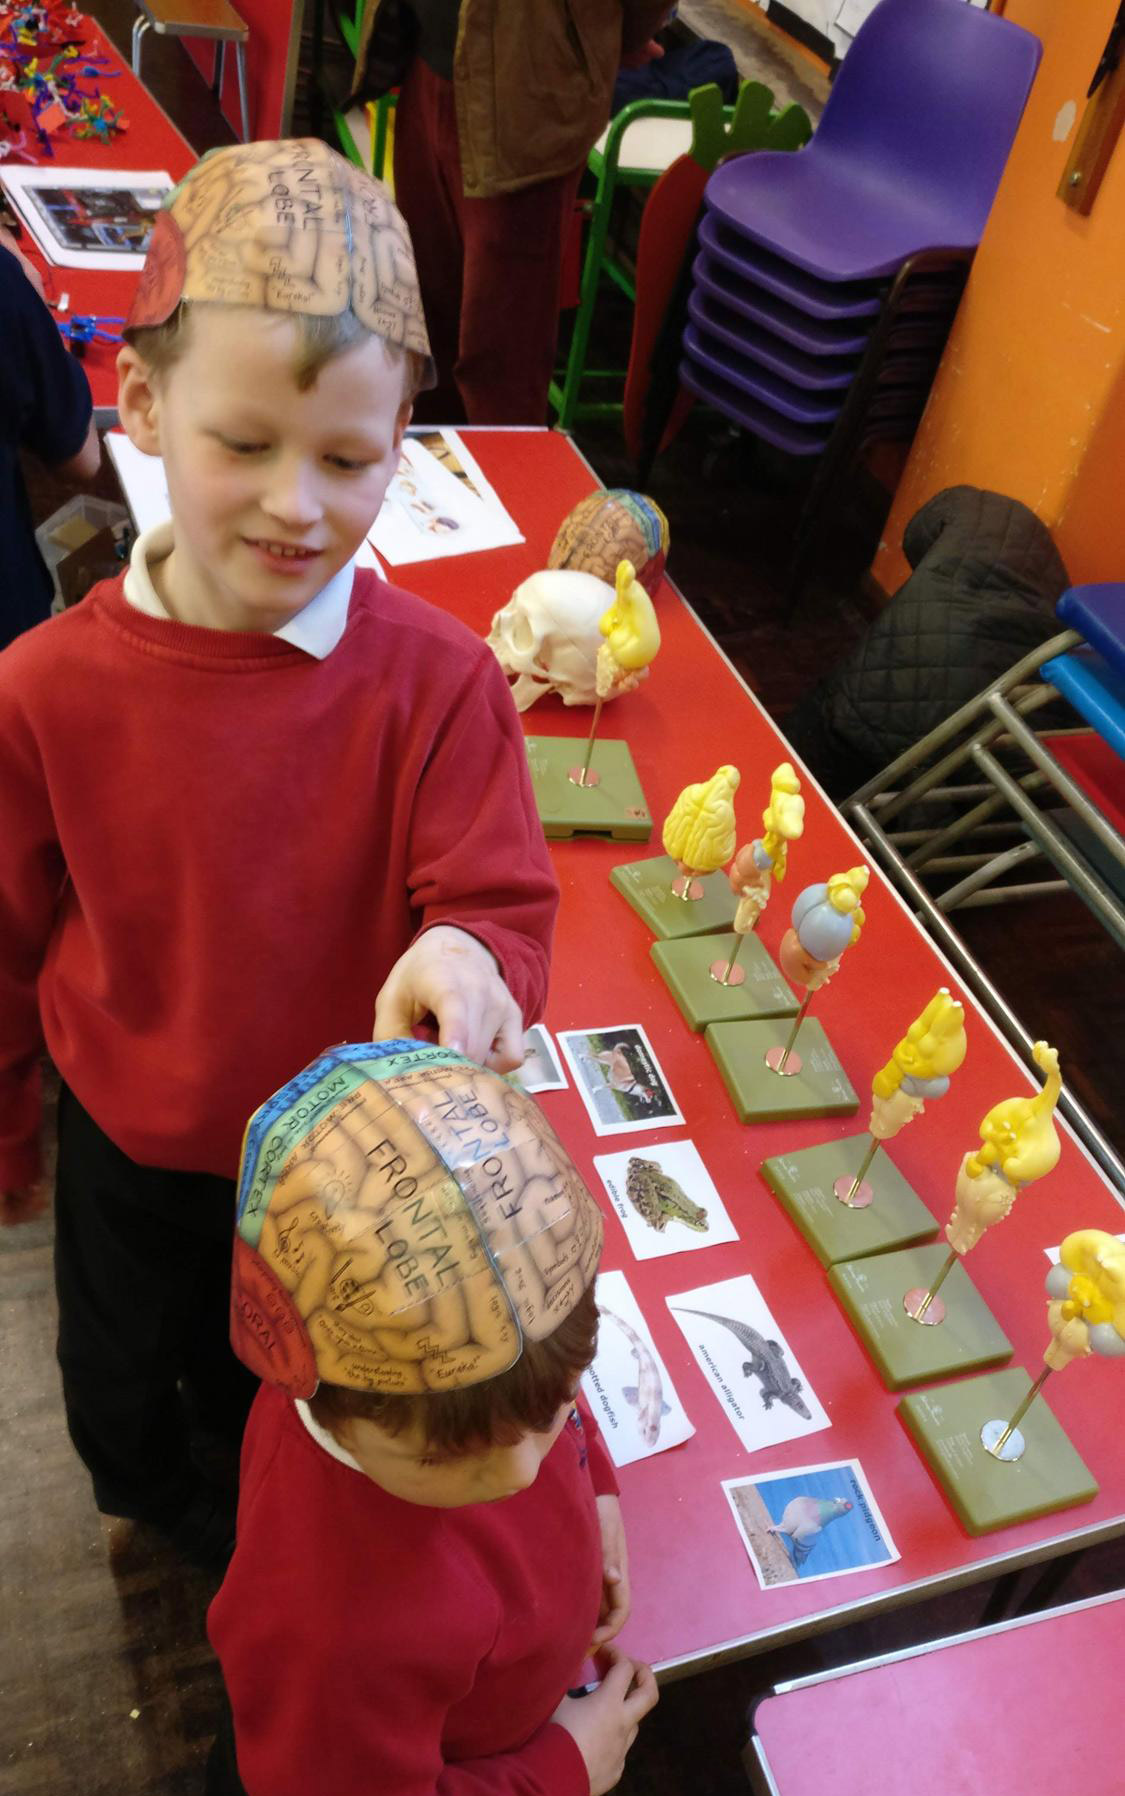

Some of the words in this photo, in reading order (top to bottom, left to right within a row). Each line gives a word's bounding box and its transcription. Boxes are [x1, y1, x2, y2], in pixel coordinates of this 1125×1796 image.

[268, 171, 295, 223] LOBE
[282, 1077, 346, 1130] MOTOR
[461, 1088, 511, 1149] LOBE
[246, 1135, 286, 1218] CORTEX
[434, 1088, 523, 1220] FRONTAL
[366, 1138, 464, 1288] FRONTAL
[606, 1179, 621, 1203] edible
[617, 1203, 628, 1218] frog
[375, 1219, 428, 1296] LOBE
[600, 1394, 620, 1429] dogfish
[698, 1343, 724, 1385] american
[721, 1383, 746, 1421] alligator
[850, 1478, 864, 1503] rock
